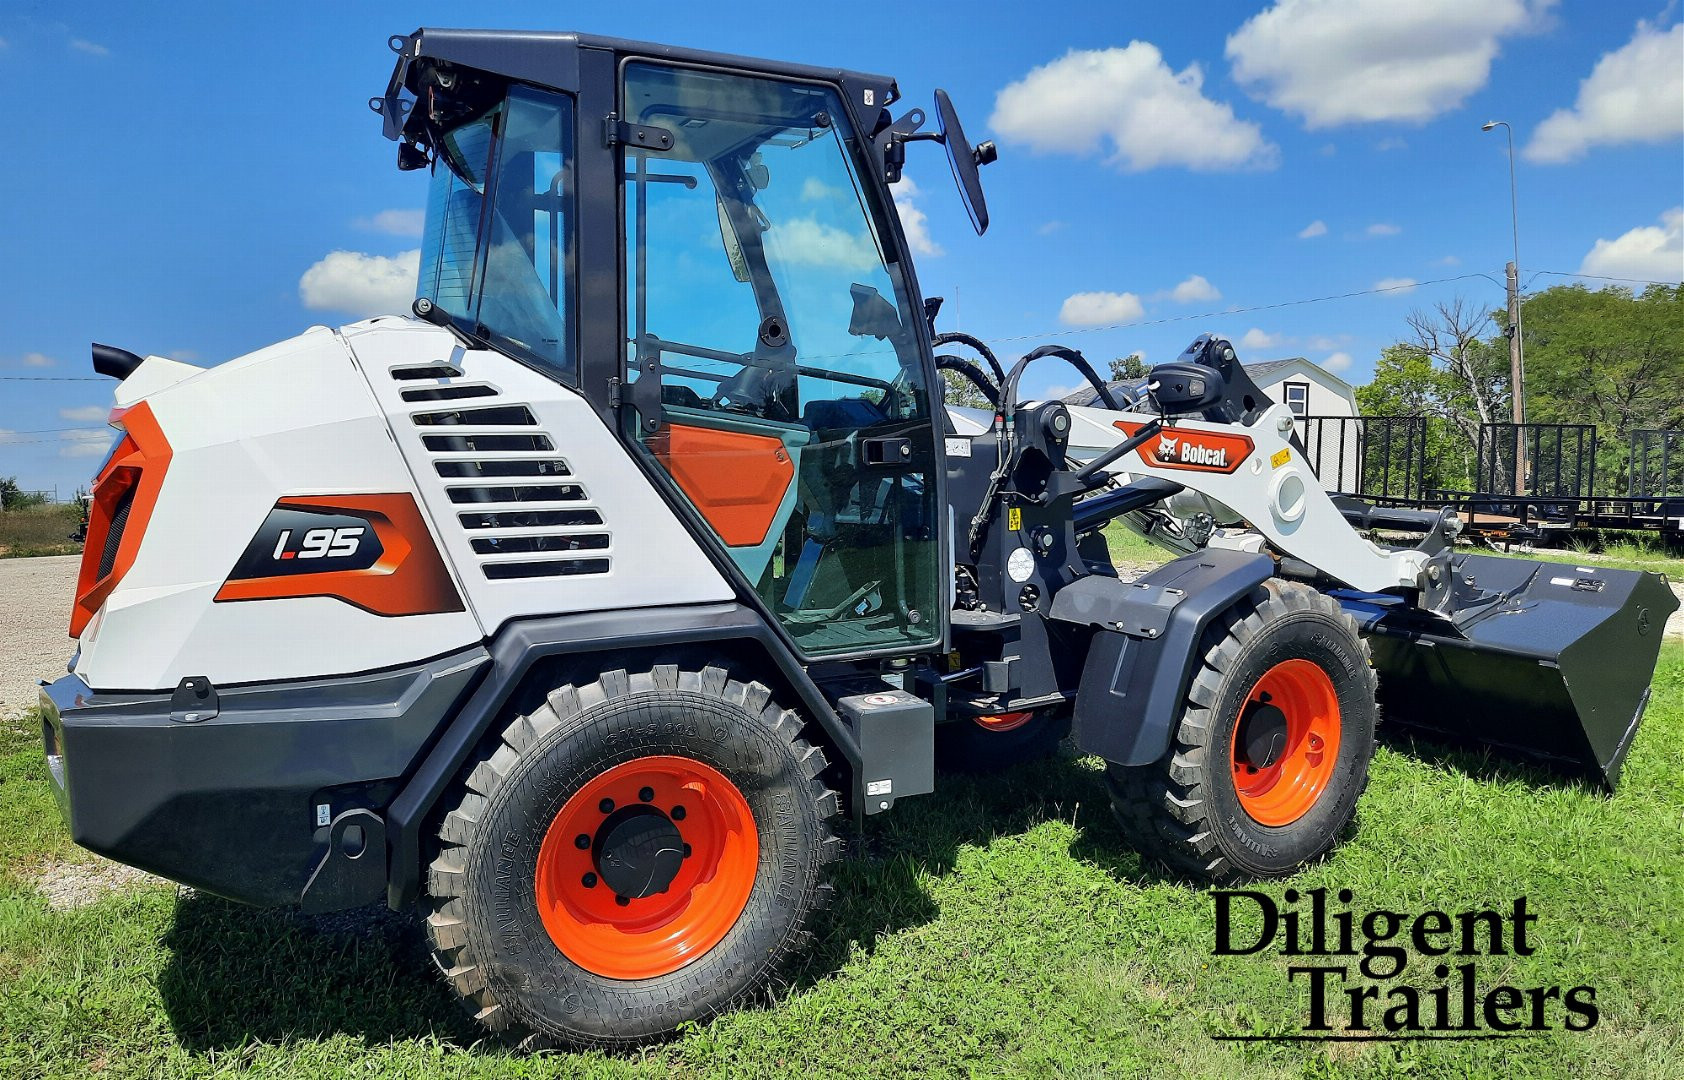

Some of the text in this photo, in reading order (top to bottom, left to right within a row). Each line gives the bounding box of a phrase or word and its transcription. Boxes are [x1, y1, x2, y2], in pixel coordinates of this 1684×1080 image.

[1180, 443, 1227, 467] Bobcat
[775, 809, 798, 908] ALLIANCE
[1226, 814, 1270, 858] ALLIANCE
[495, 829, 521, 938] ALLIANCE
